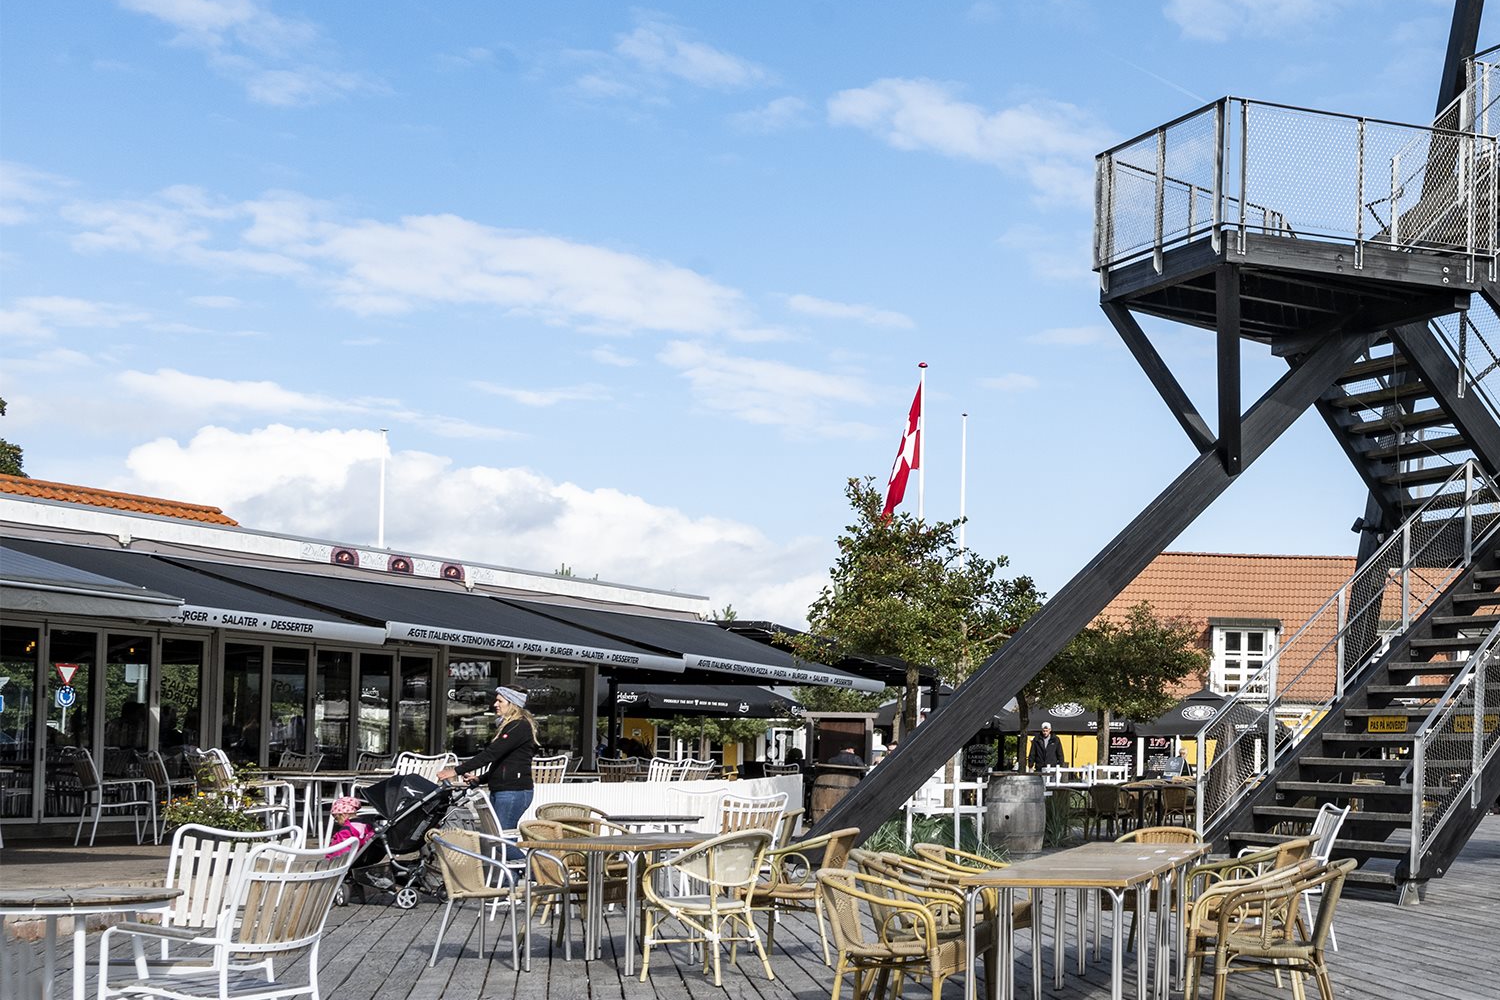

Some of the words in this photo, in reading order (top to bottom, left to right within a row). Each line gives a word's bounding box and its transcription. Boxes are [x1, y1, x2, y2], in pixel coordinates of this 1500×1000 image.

[172, 610, 208, 622] RGER
[222, 614, 258, 627] SALATER
[271, 620, 314, 633] DESSERTER
[407, 628, 428, 638] ÆGTE
[428, 630, 461, 642] ITALIENSK
[462, 634, 496, 647] STENOVNS
[496, 639, 514, 649] PIZZA
[523, 643, 542, 653] PASTA
[550, 646, 574, 656] BURGER
[581, 650, 604, 660] SALATER
[611, 654, 639, 664] DESSERTER
[756, 667, 768, 675] PIZZA
[792, 672, 808, 680] BURGER
[834, 678, 853, 686] DESSERTER
[1370, 721, 1378, 730] PAS
[1380, 720, 1385, 730] PÅ
[1386, 721, 1406, 730] HOVEDET
